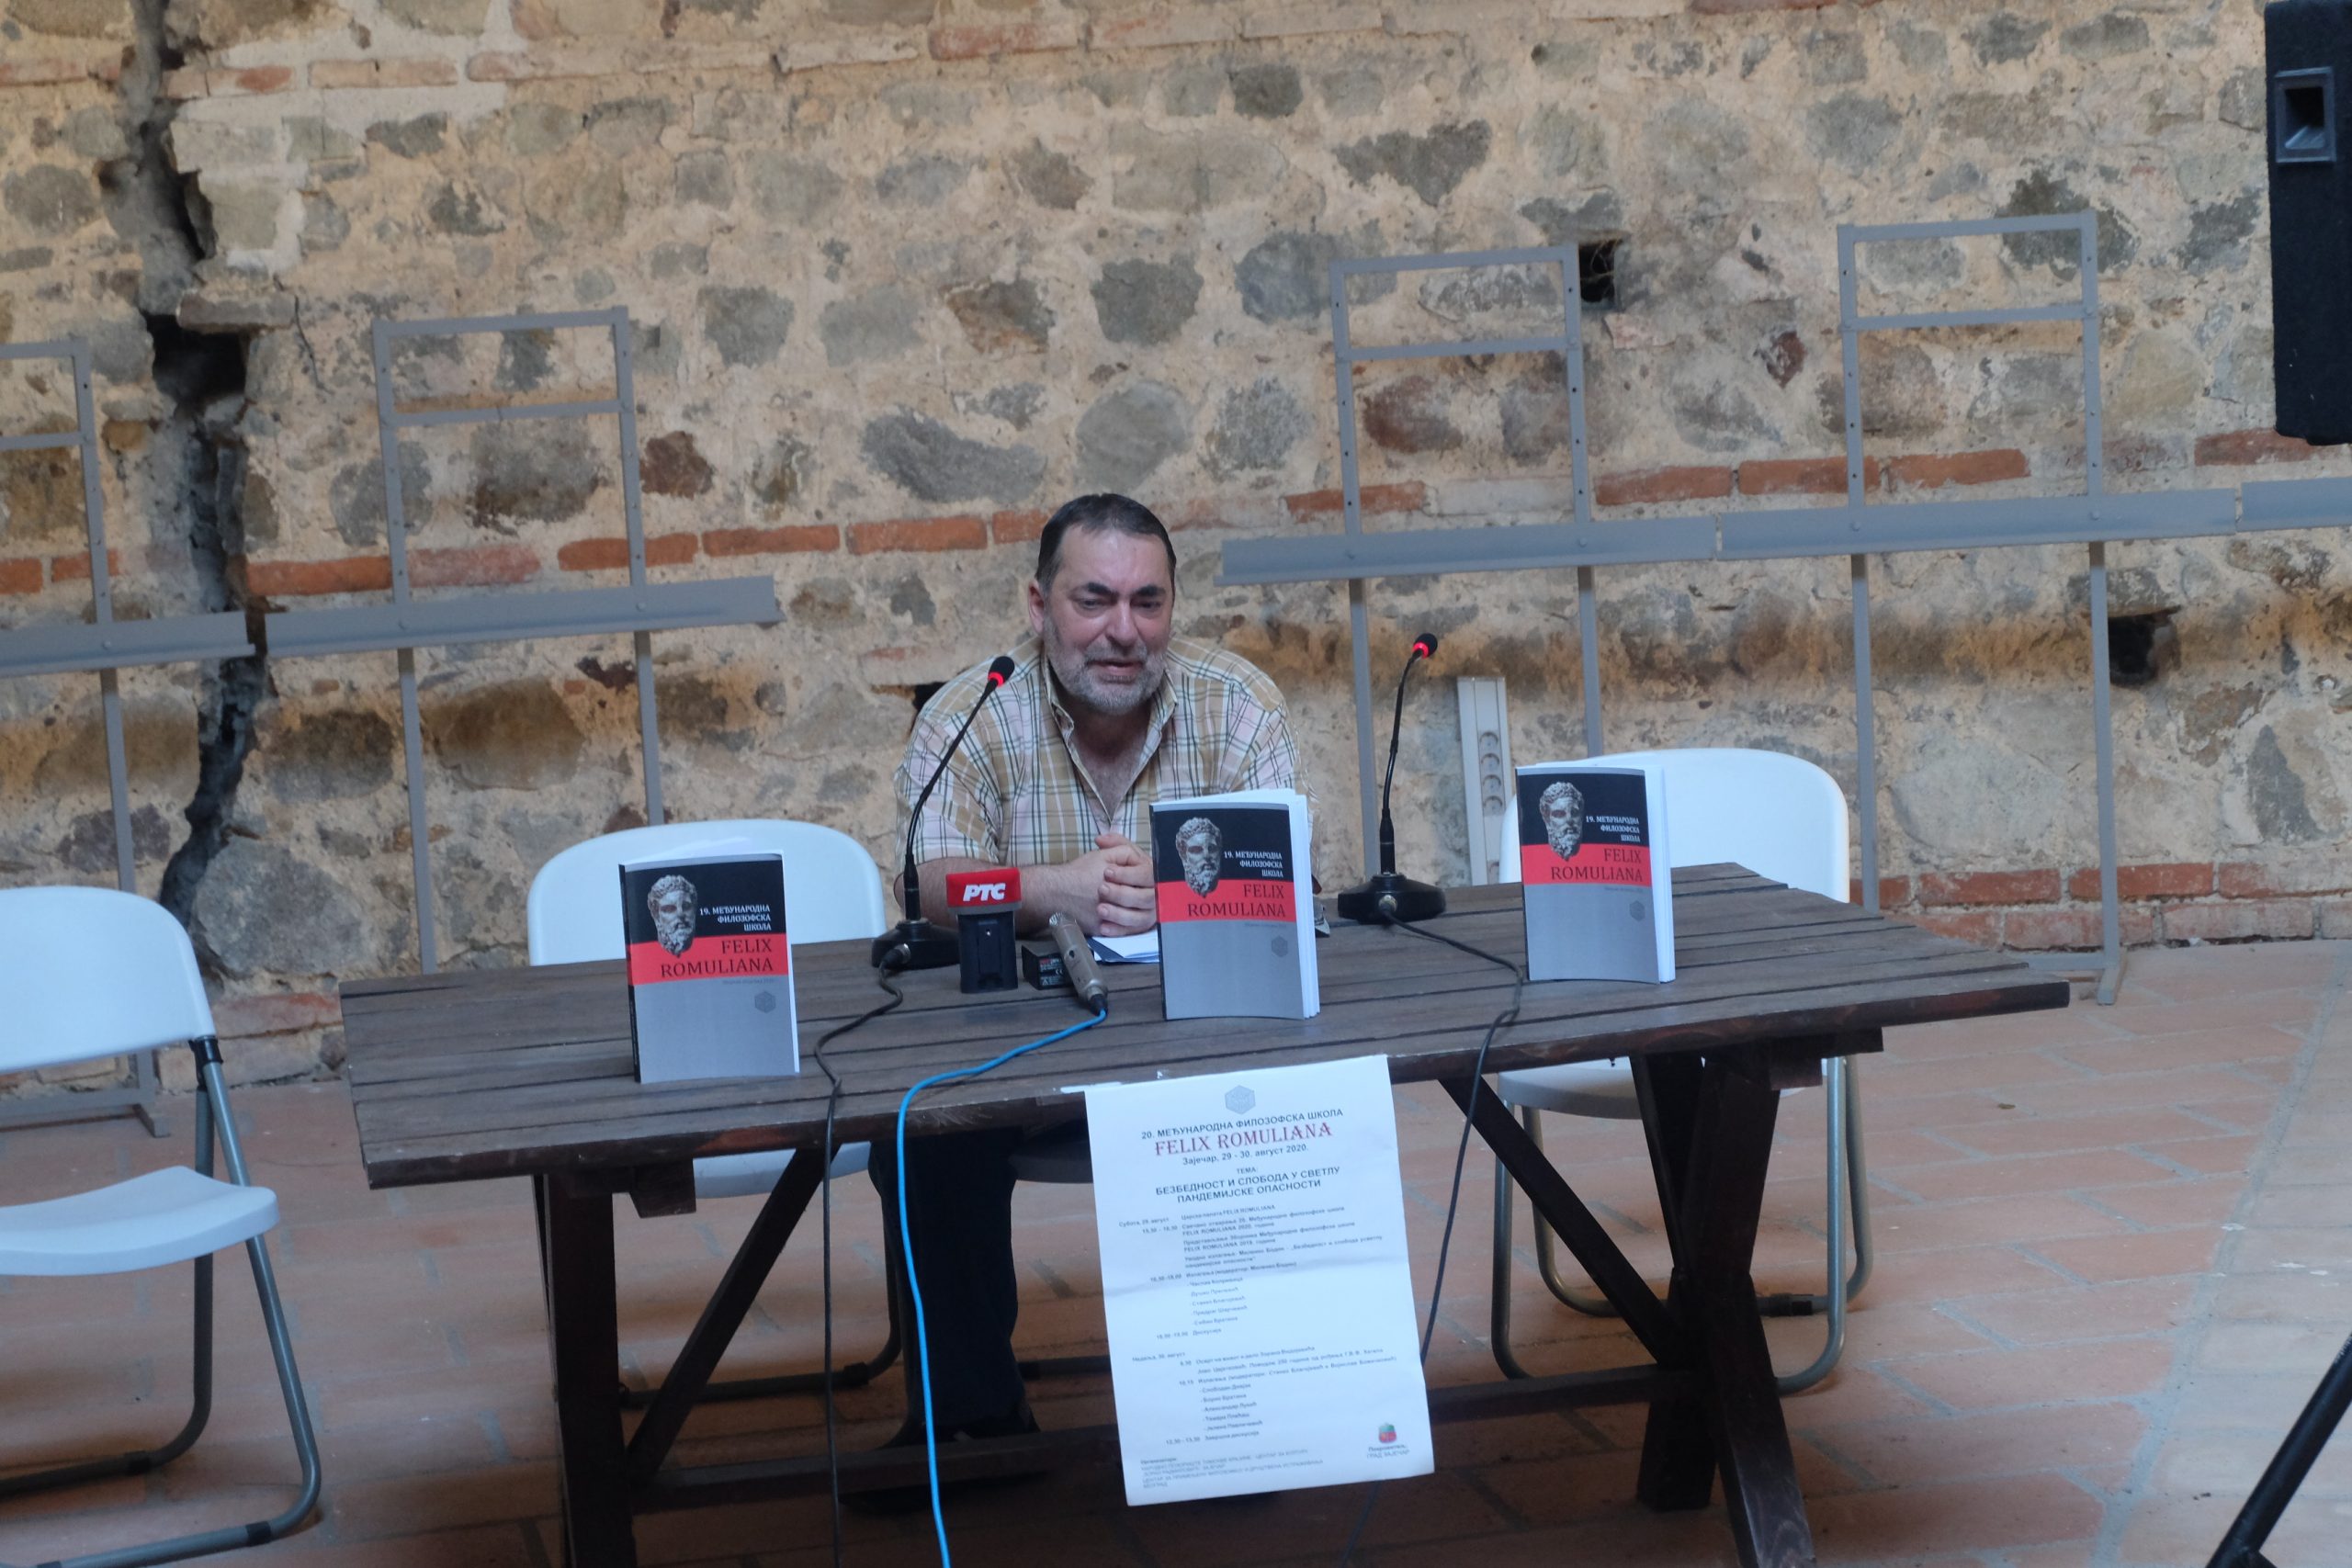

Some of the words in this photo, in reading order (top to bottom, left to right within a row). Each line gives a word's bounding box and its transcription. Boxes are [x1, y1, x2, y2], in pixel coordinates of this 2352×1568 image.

[1600, 825, 1640, 833] ФИЛОЗОФСКА
[1621, 834, 1640, 842] ШКОЛА
[1235, 851, 1283, 860] МЕЂУНАРОДНА
[1603, 848, 1642, 863] FELIX
[1239, 860, 1283, 869] ФИЛОЗОФСКА
[1551, 866, 1644, 882] ROMULIANA
[1243, 884, 1284, 899] FELIX
[699, 908, 710, 916] 19.
[712, 904, 771, 915] МЕЂУНАРОДНА
[1187, 902, 1286, 918] ROMULIANA
[717, 914, 771, 924] ФИЛОЗОФСКА
[743, 923, 772, 931] ШКОЛА
[721, 939, 772, 954] FELIX
[661, 958, 774, 978] ROMULIANA
[1141, 1131, 1154, 1139] 20.
[1158, 1121, 1232, 1139] МЕЂУНАРОДНА
[1236, 1112, 1305, 1129] ФИЛОЗОФСКА
[1307, 1108, 1343, 1121] ШКОЛА
[1154, 1134, 1211, 1156] FELIX
[1217, 1121, 1332, 1149] ROMULIANA
[1222, 1152, 1231, 1160] 29
[1255, 1146, 1283, 1157] август
[1155, 1179, 1224, 1196] БЕЗБЕДНОСТ
[1227, 1179, 1235, 1187] И
[1238, 1172, 1288, 1187] СЛОБОДА
[1291, 1171, 1297, 1179] У
[1300, 1166, 1340, 1178] СВЕТЛУ
[1177, 1187, 1253, 1203] ПАНДЕМИЈСКЕ
[1256, 1179, 1321, 1193] ОПАСНОСТИ
